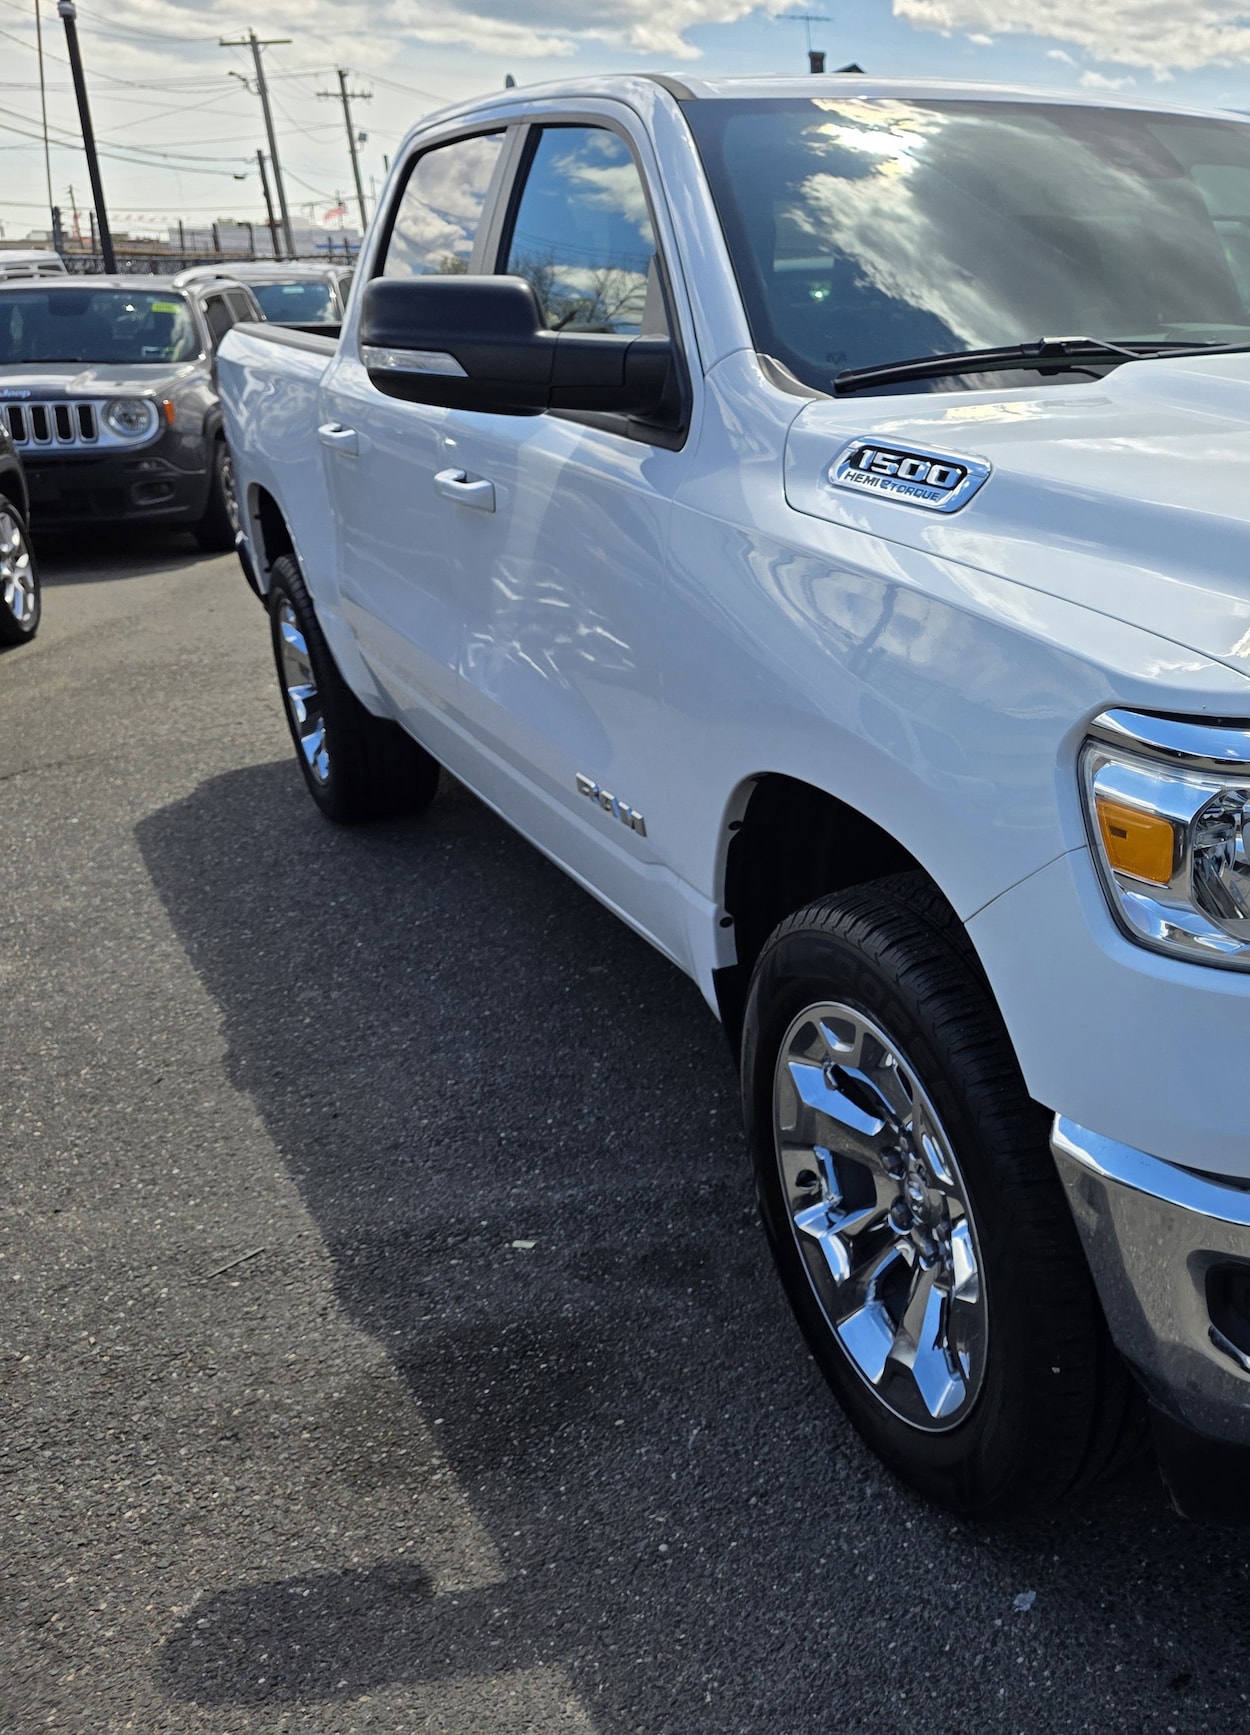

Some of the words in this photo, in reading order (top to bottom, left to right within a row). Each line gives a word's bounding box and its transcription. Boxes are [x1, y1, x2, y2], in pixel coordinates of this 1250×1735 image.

[844, 470, 880, 487] HEMI
[858, 449, 963, 489] 1500
[575, 771, 647, 838] RAM
